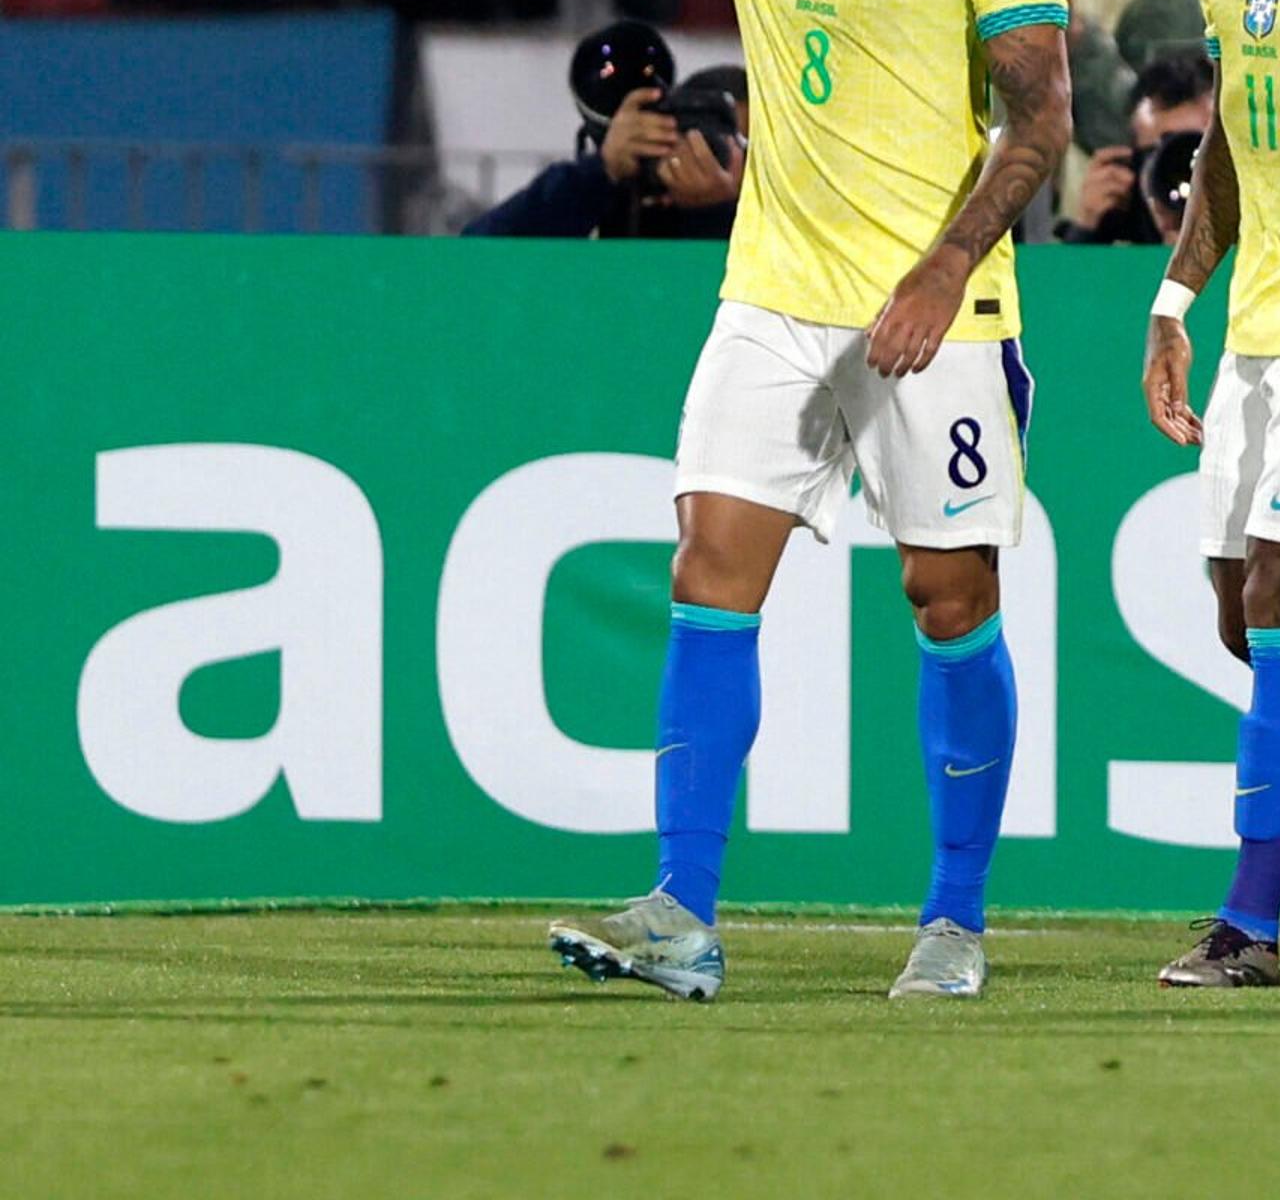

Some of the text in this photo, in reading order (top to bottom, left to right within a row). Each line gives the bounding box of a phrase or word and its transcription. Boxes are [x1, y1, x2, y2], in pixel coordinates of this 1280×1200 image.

[801, 29, 832, 105] 8
[1245, 74, 1277, 150] 11
[947, 416, 988, 490] 8
